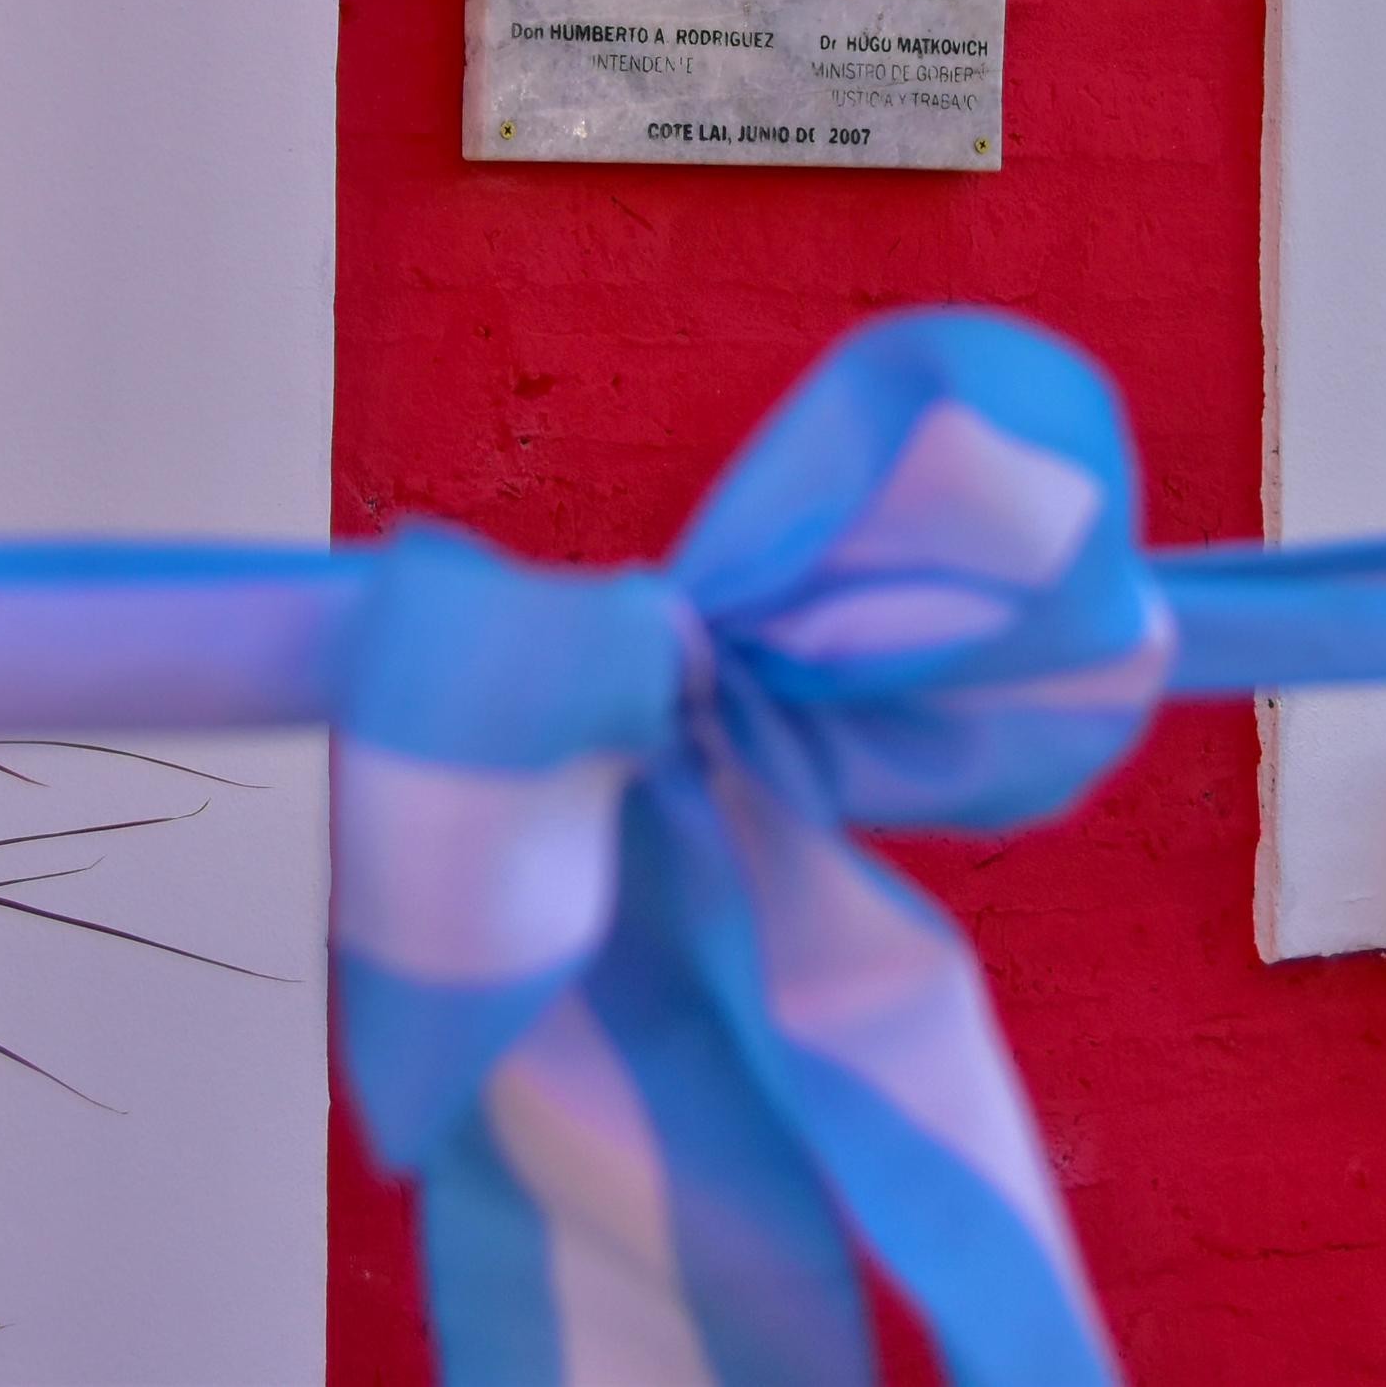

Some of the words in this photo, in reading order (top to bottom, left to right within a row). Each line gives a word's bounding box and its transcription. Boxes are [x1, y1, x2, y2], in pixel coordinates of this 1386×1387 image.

[511, 22, 544, 40] Don
[550, 23, 649, 44] HUMBERTO
[676, 29, 775, 49] RODRIGUEZ
[847, 36, 891, 53] HUGO
[897, 36, 989, 56] MATKOVICH
[891, 65, 910, 83] DE
[916, 63, 988, 83] GOBIER
[647, 122, 693, 141] COTE
[698, 124, 731, 145] LAI,
[737, 125, 790, 143] JUNIO
[828, 127, 871, 145] 2007
